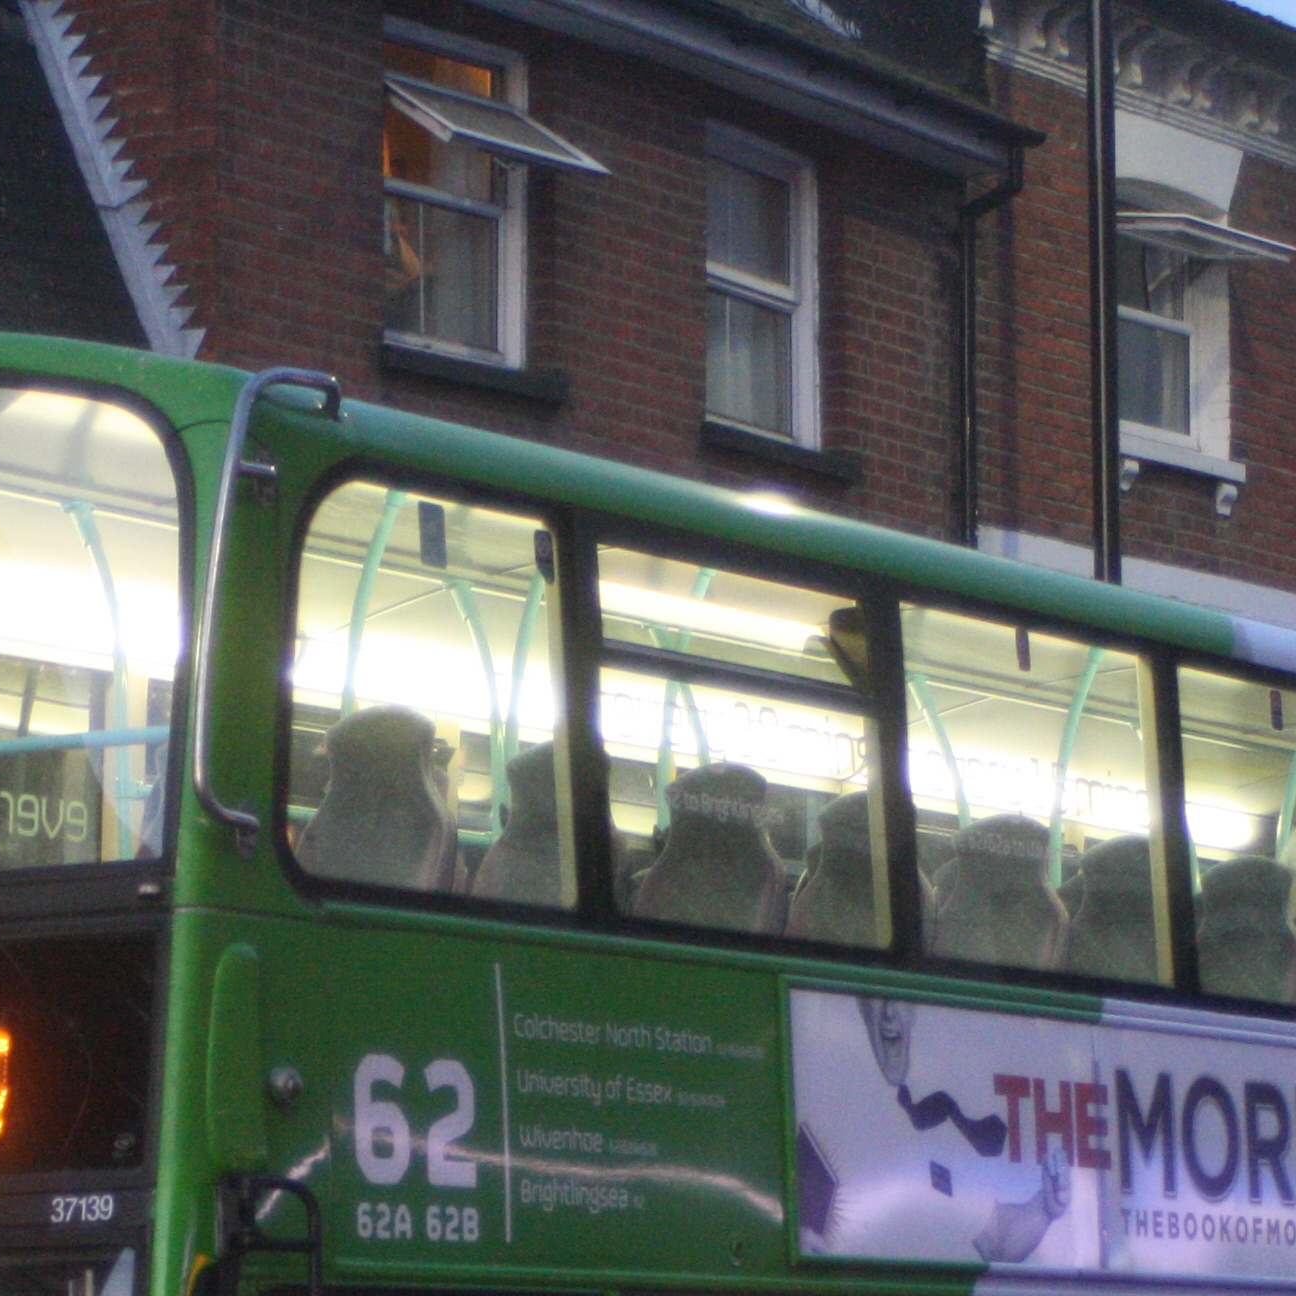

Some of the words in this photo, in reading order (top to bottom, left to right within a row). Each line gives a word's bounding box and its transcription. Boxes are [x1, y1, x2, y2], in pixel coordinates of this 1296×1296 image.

[513, 1012, 600, 1046] Colchester
[606, 1023, 652, 1048] North
[655, 1026, 713, 1054] Station
[516, 1068, 602, 1108] University
[606, 1074, 623, 1101] of
[626, 1076, 673, 1104] Essex
[353, 1053, 478, 1188] 62
[519, 1125, 604, 1154] Wivenhoe
[993, 1074, 1111, 1171] THE
[50, 1194, 114, 1223] 37139
[521, 1179, 629, 1215] Brightlingsea
[355, 1201, 413, 1240] 62A
[426, 1205, 480, 1242] 62B
